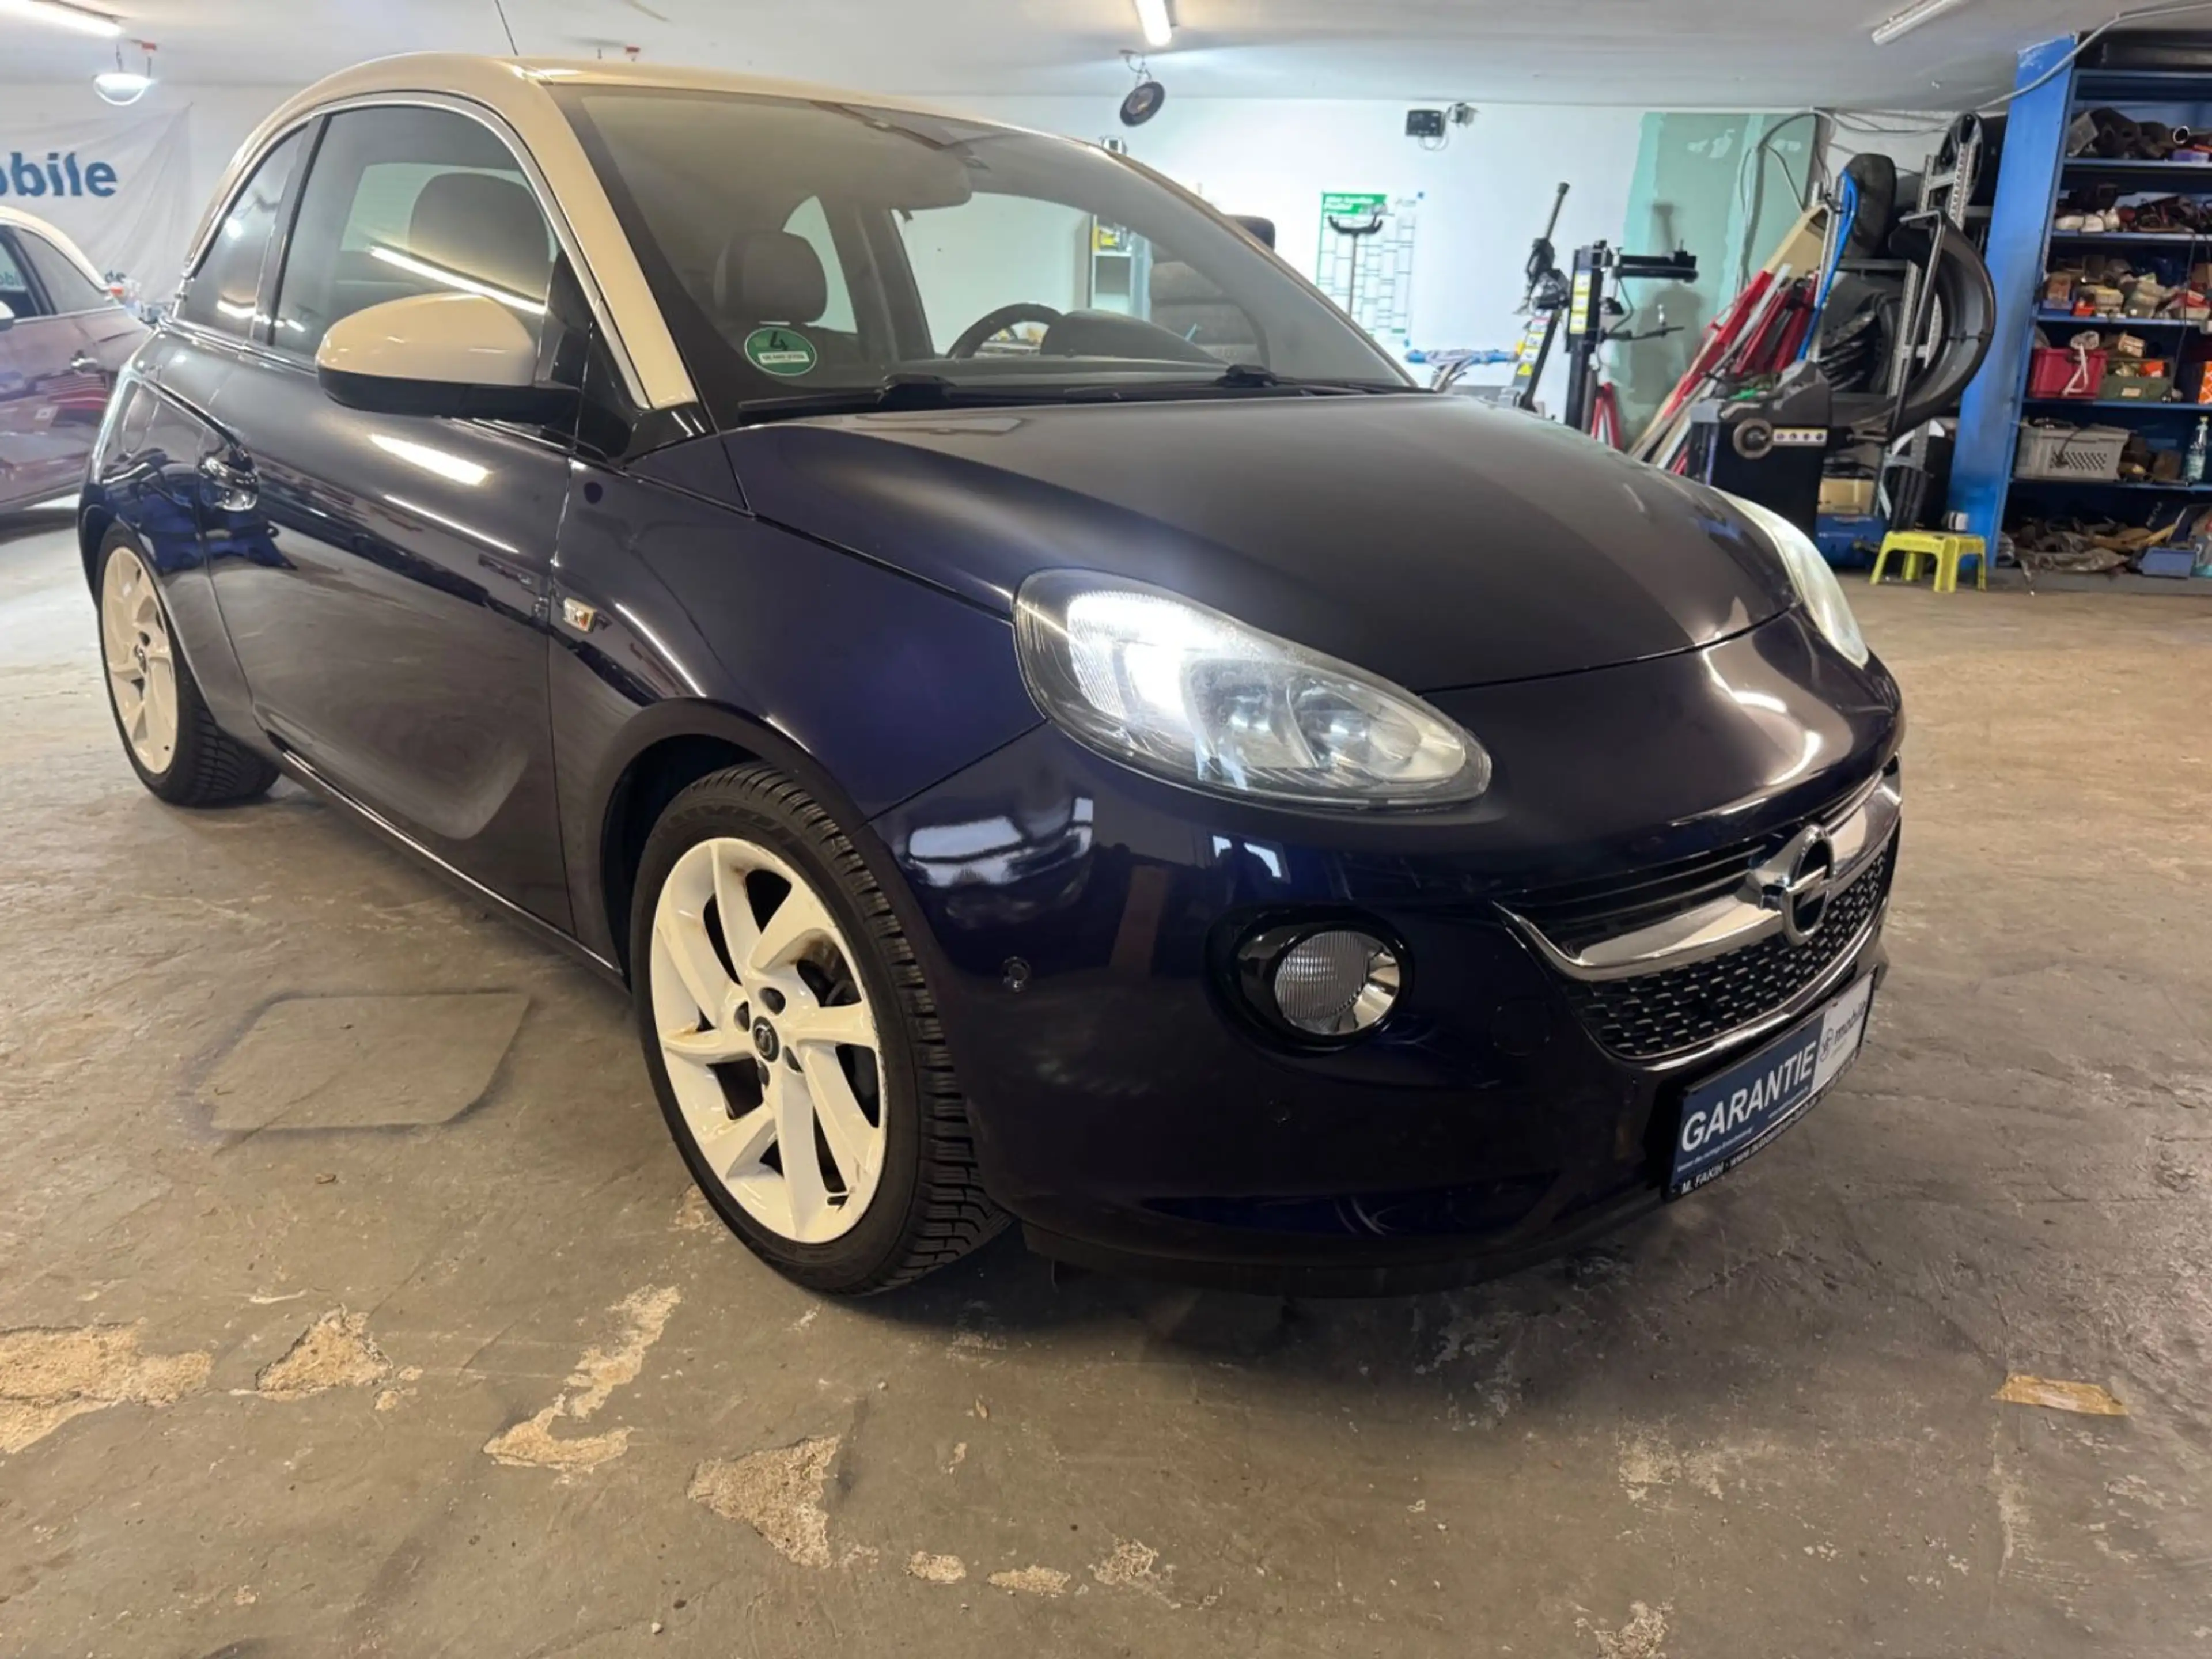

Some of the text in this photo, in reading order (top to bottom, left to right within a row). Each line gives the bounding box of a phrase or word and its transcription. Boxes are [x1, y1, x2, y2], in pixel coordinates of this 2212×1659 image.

[0, 151, 118, 198] bile
[770, 331, 788, 351] 4
[1681, 1041, 1816, 1152] GARANTIE
